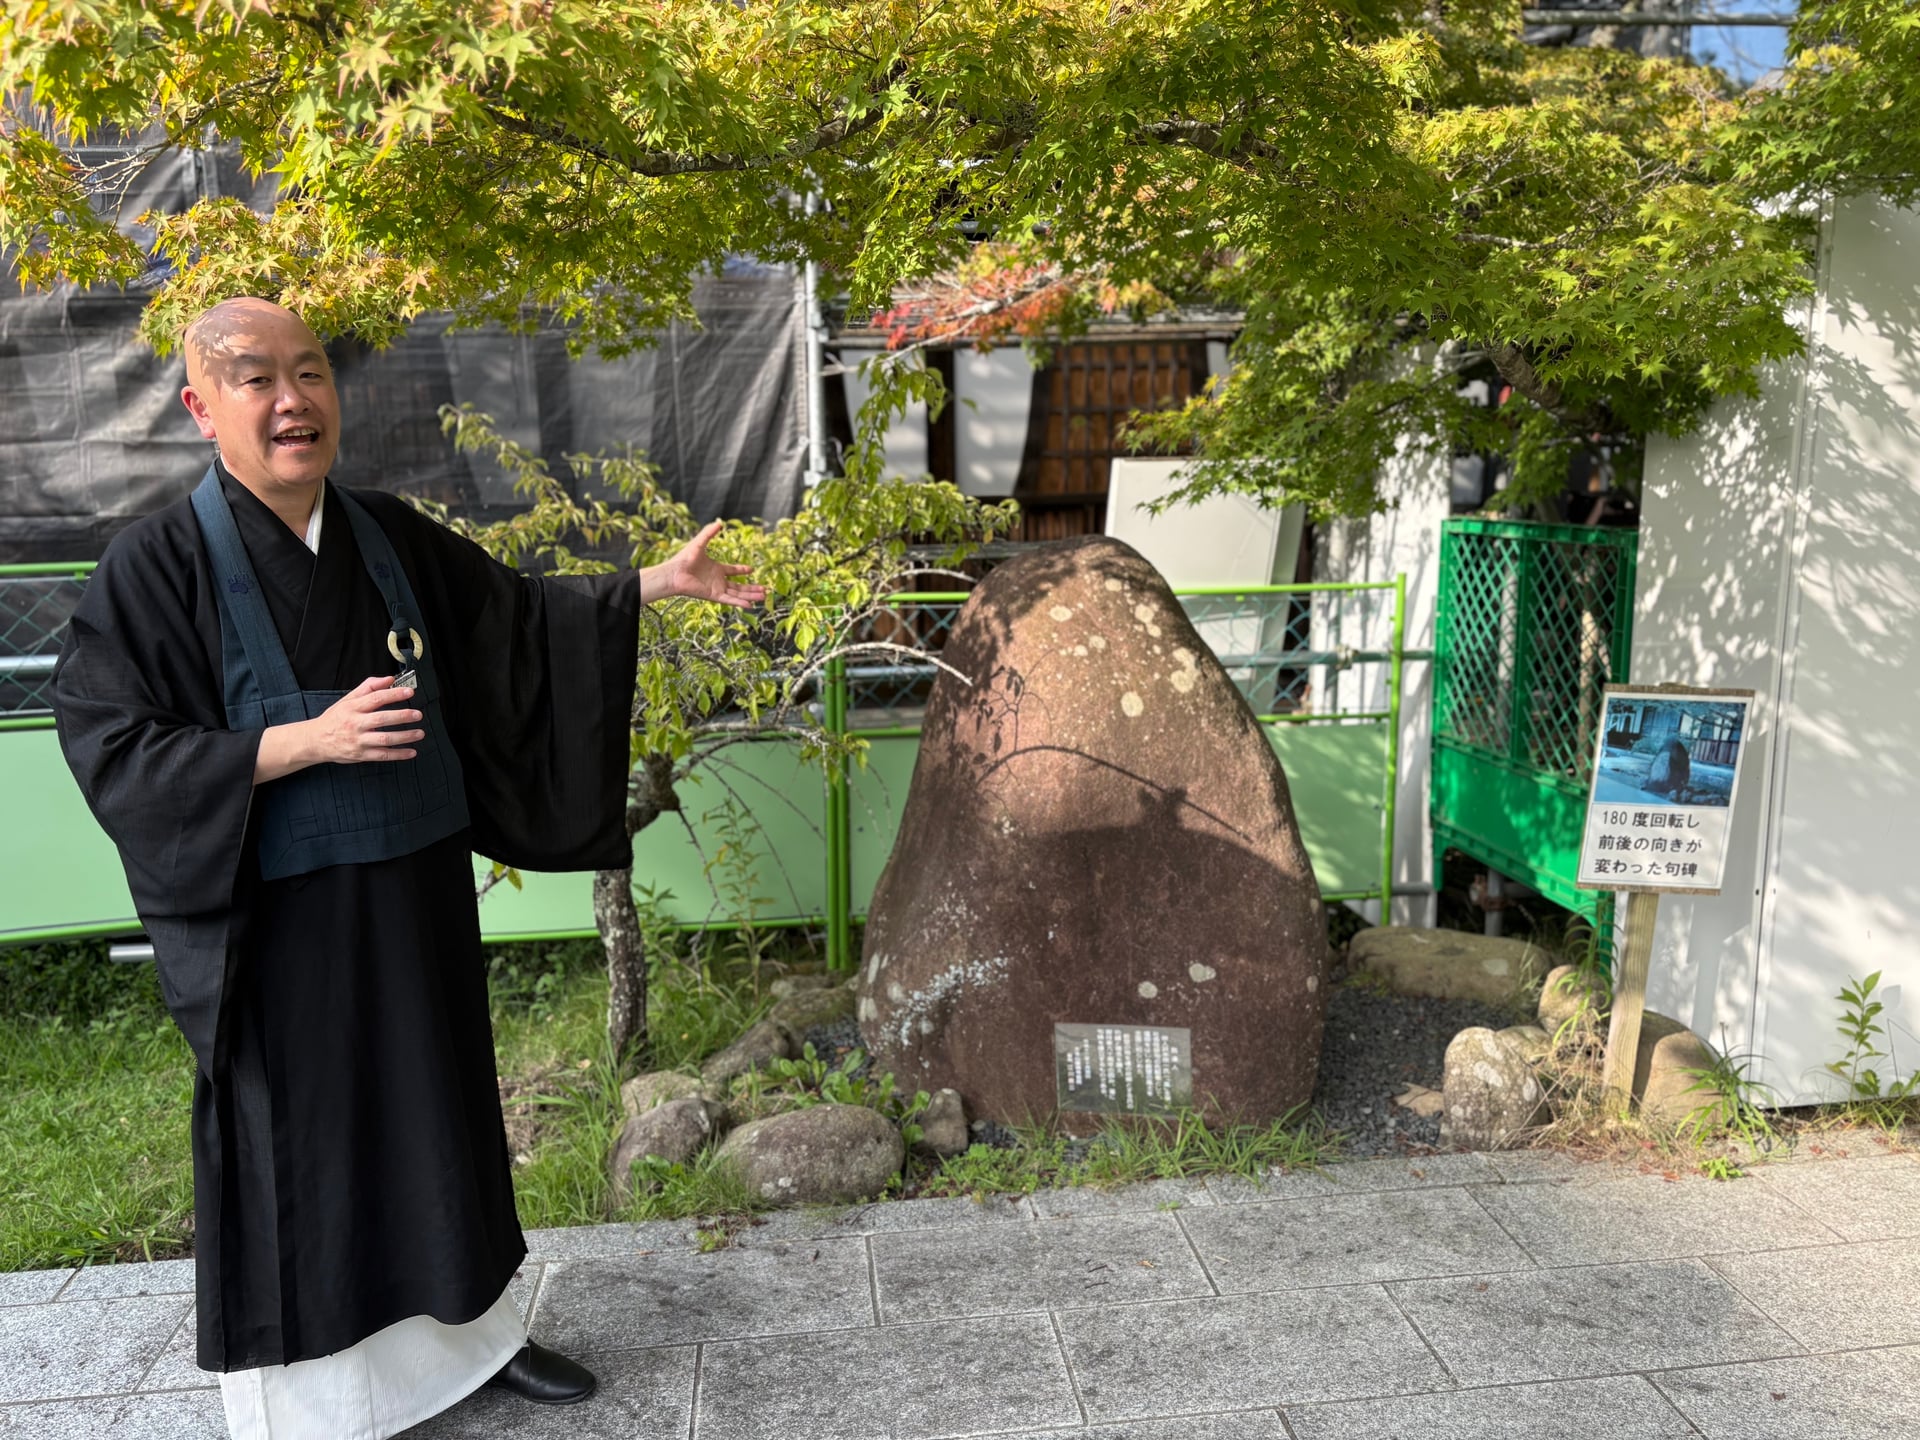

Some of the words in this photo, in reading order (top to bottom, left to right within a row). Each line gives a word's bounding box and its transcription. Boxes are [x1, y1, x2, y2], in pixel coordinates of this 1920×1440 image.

[1598, 834, 1702, 853] 前後の向きが
[1594, 858, 1698, 877] 変わった句碑
